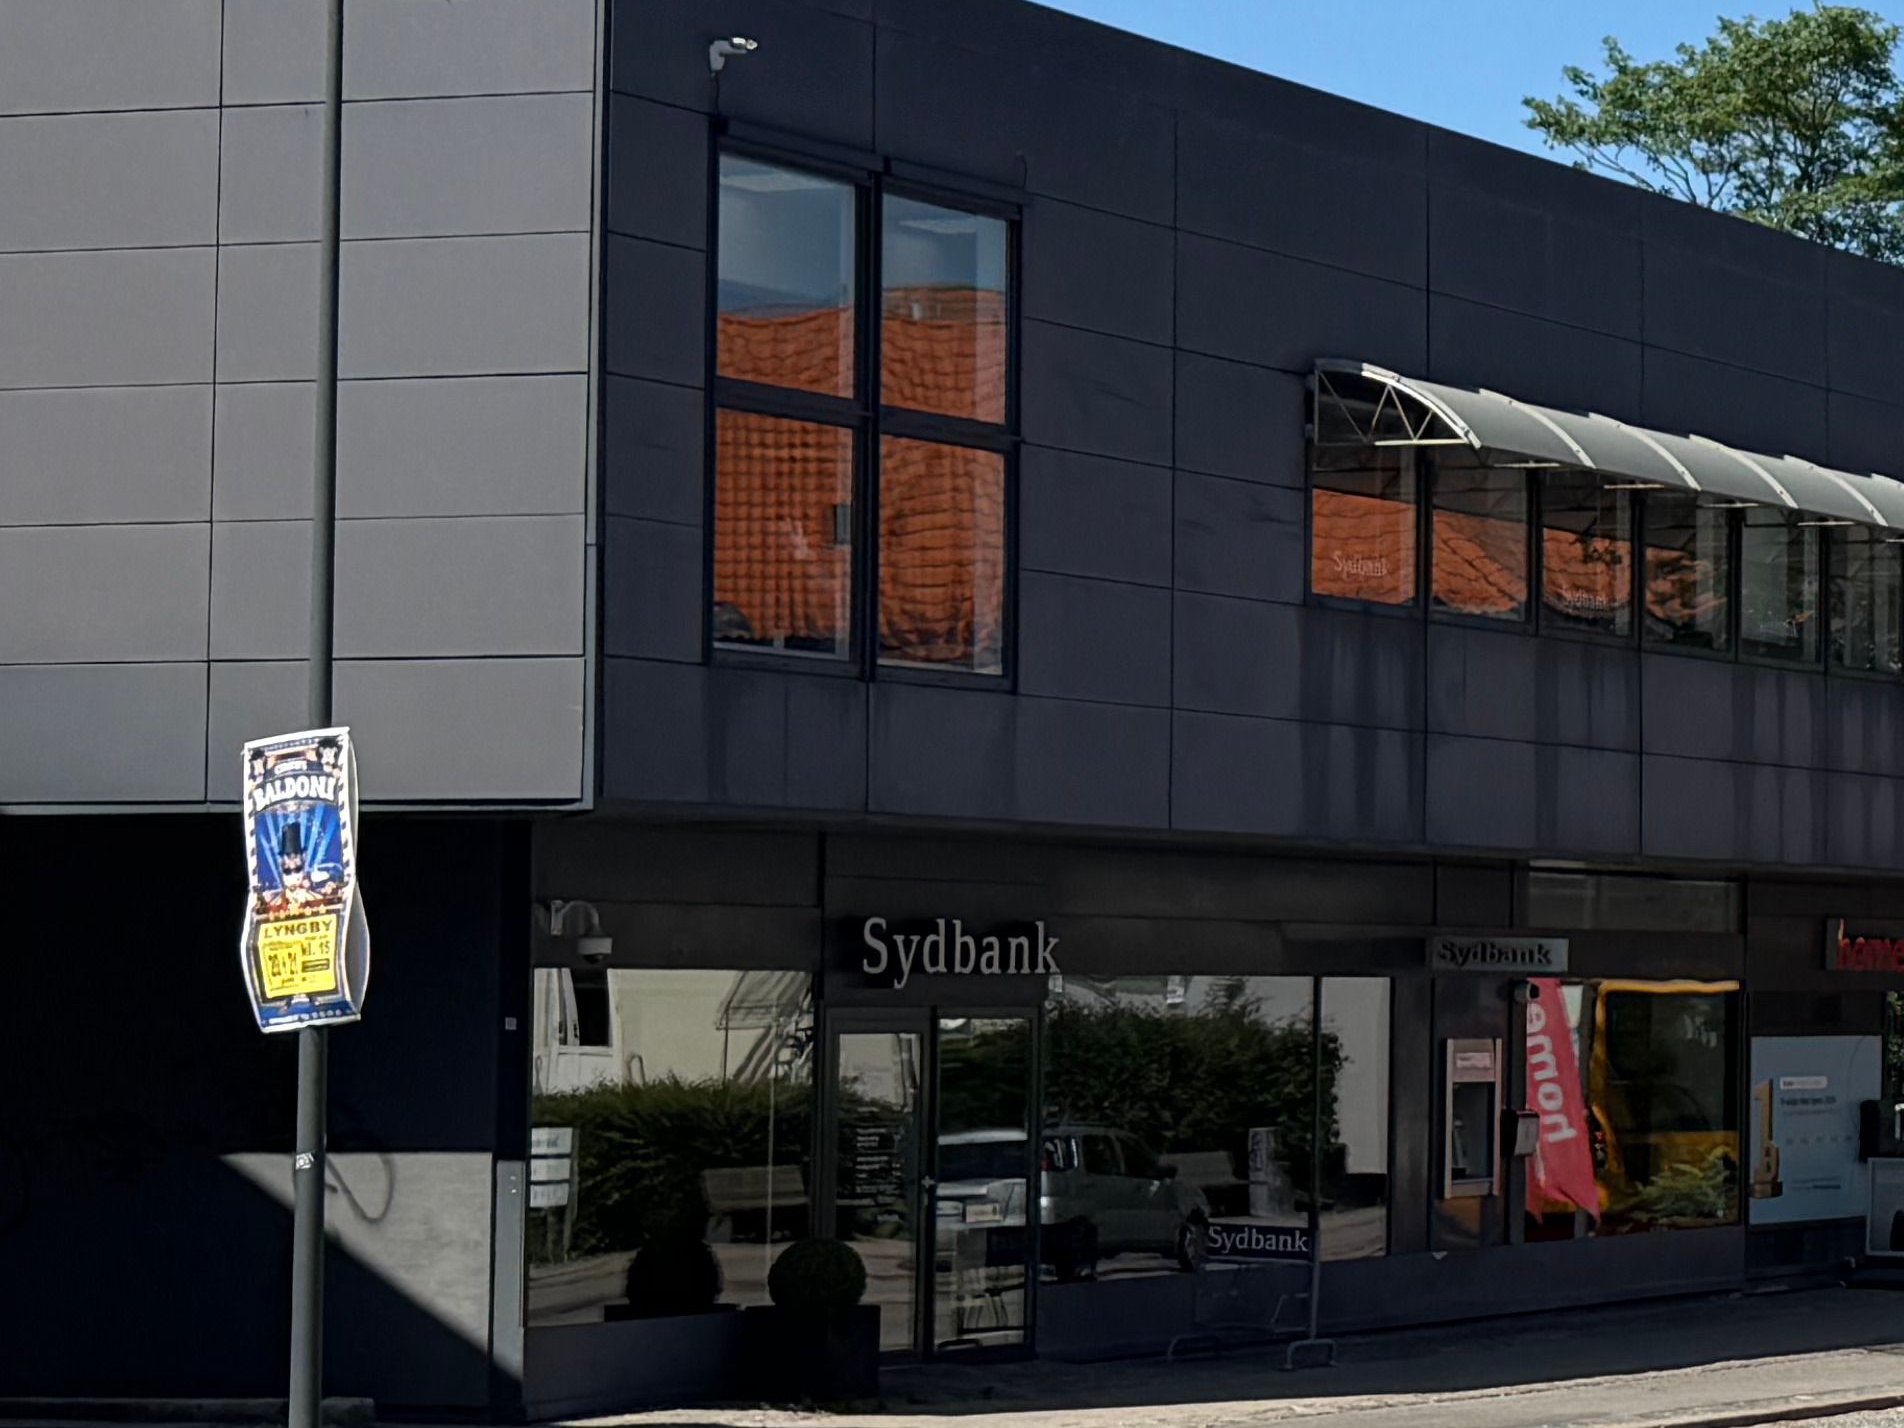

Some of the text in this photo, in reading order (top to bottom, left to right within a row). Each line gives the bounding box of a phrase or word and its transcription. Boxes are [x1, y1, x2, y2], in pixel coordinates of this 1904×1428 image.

[253, 775, 336, 812] BALDONI
[263, 919, 333, 939] LYNGBY
[863, 916, 1061, 990] Sydbank
[1439, 939, 1553, 967] Sydbank
[1207, 1225, 1309, 1254] Sydbank
